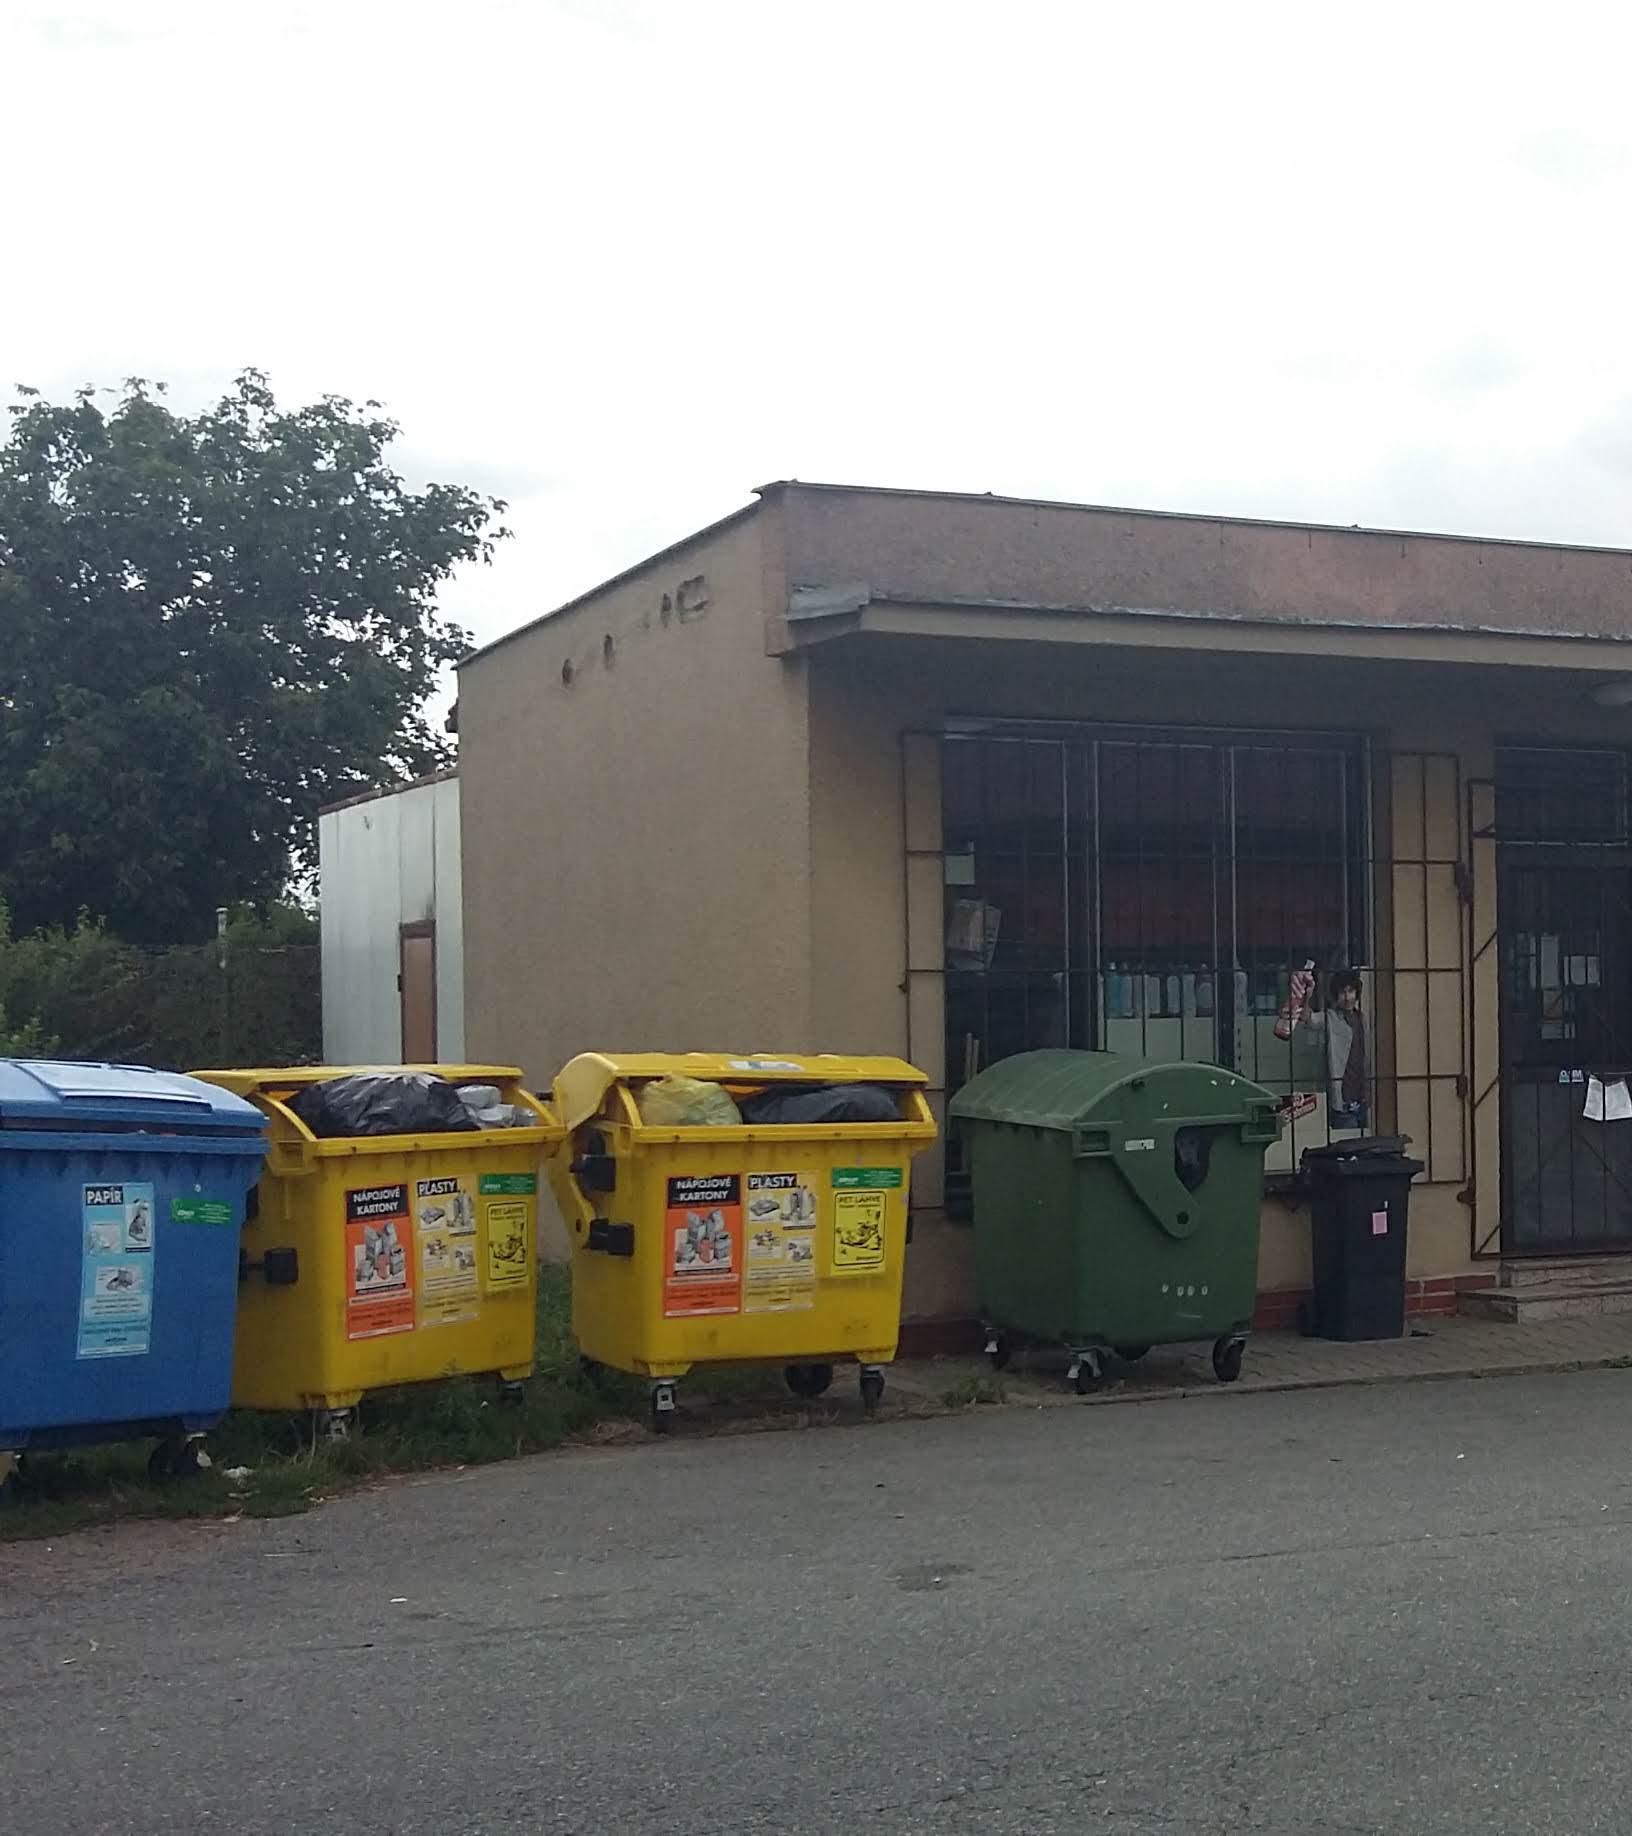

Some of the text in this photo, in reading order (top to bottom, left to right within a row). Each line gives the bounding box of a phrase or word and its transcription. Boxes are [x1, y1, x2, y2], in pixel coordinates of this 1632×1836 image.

[418, 1180, 457, 1197] PLASTY
[676, 1176, 732, 1190] NÁPOJOVÉ
[749, 1175, 795, 1188] PLASTY
[87, 1187, 122, 1204] PAPÍR
[353, 1186, 401, 1204] NÁPOJOVÉ
[679, 1190, 729, 1202] KARTONY
[356, 1201, 399, 1216] KARTONY
